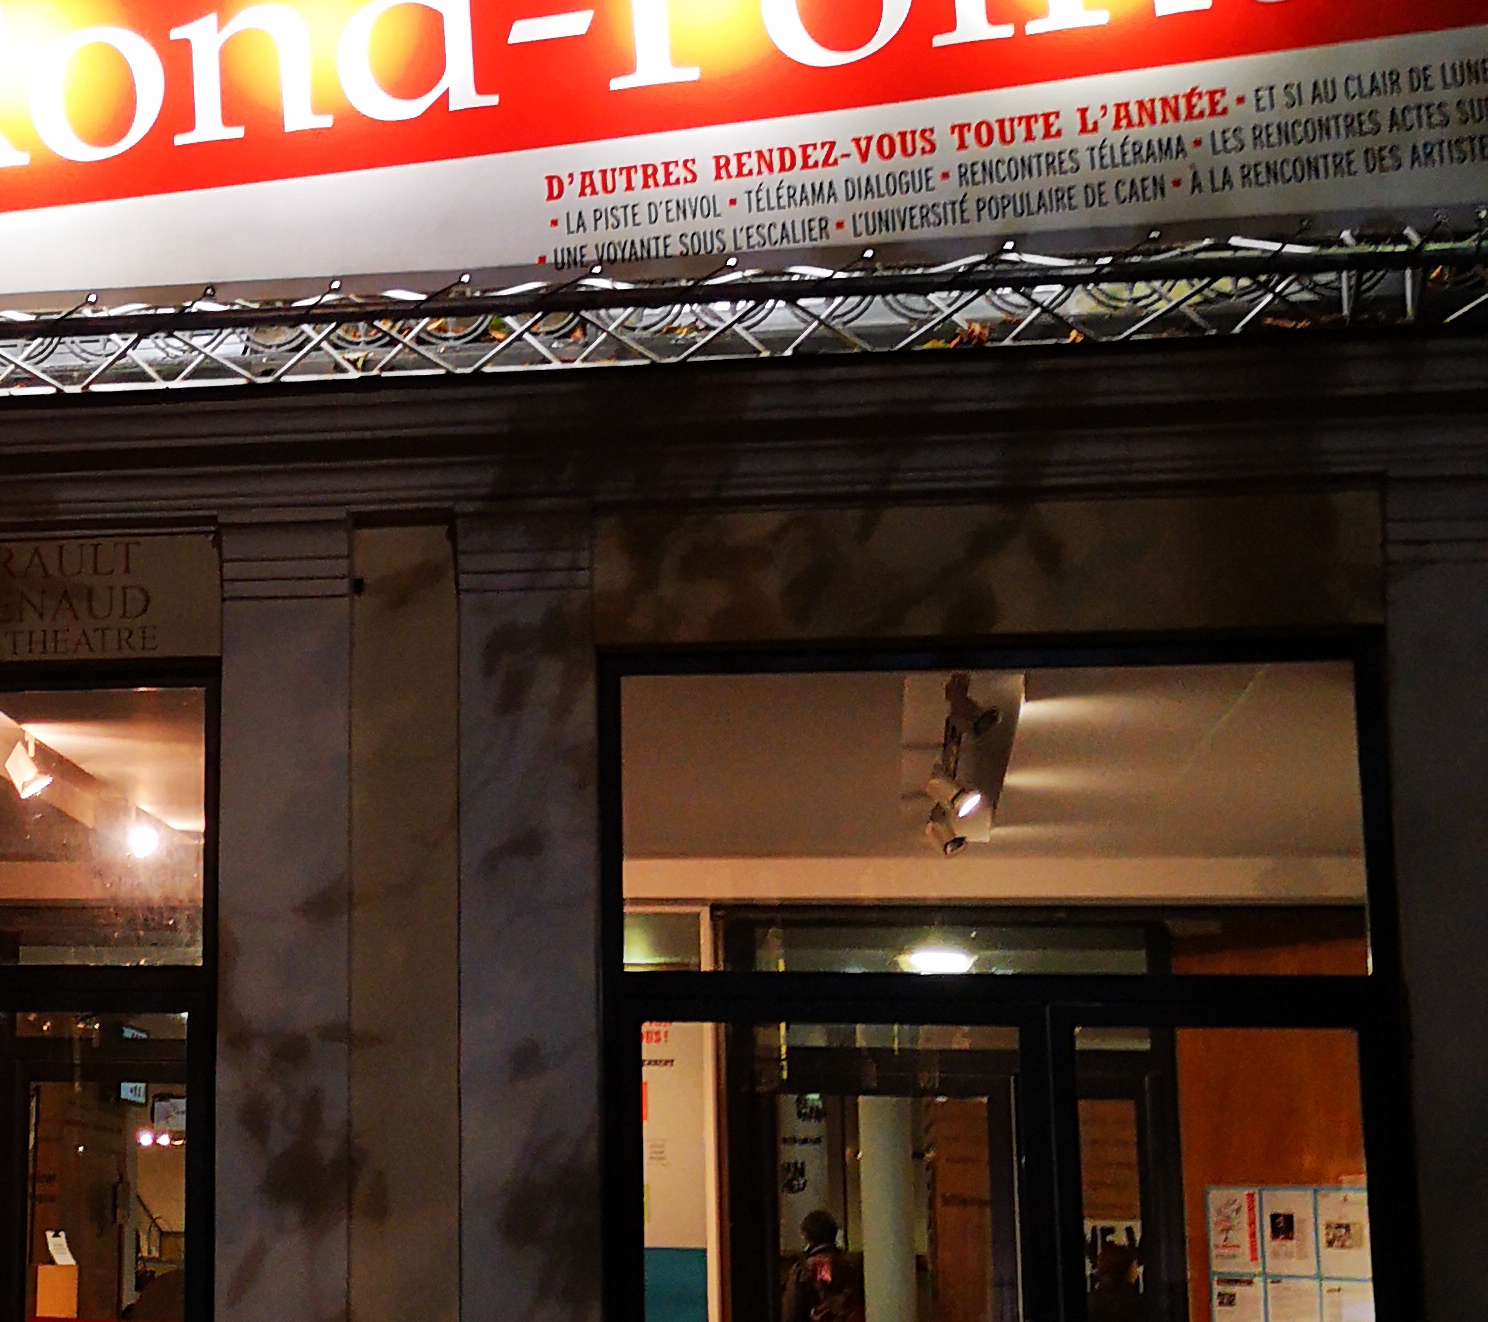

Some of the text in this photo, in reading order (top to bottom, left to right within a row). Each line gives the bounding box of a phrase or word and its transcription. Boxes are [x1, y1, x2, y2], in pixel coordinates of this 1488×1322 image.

[546, 88, 1229, 201] D'AUTRES RENDEZ-VOUS TOUTE L'ANNÉE
